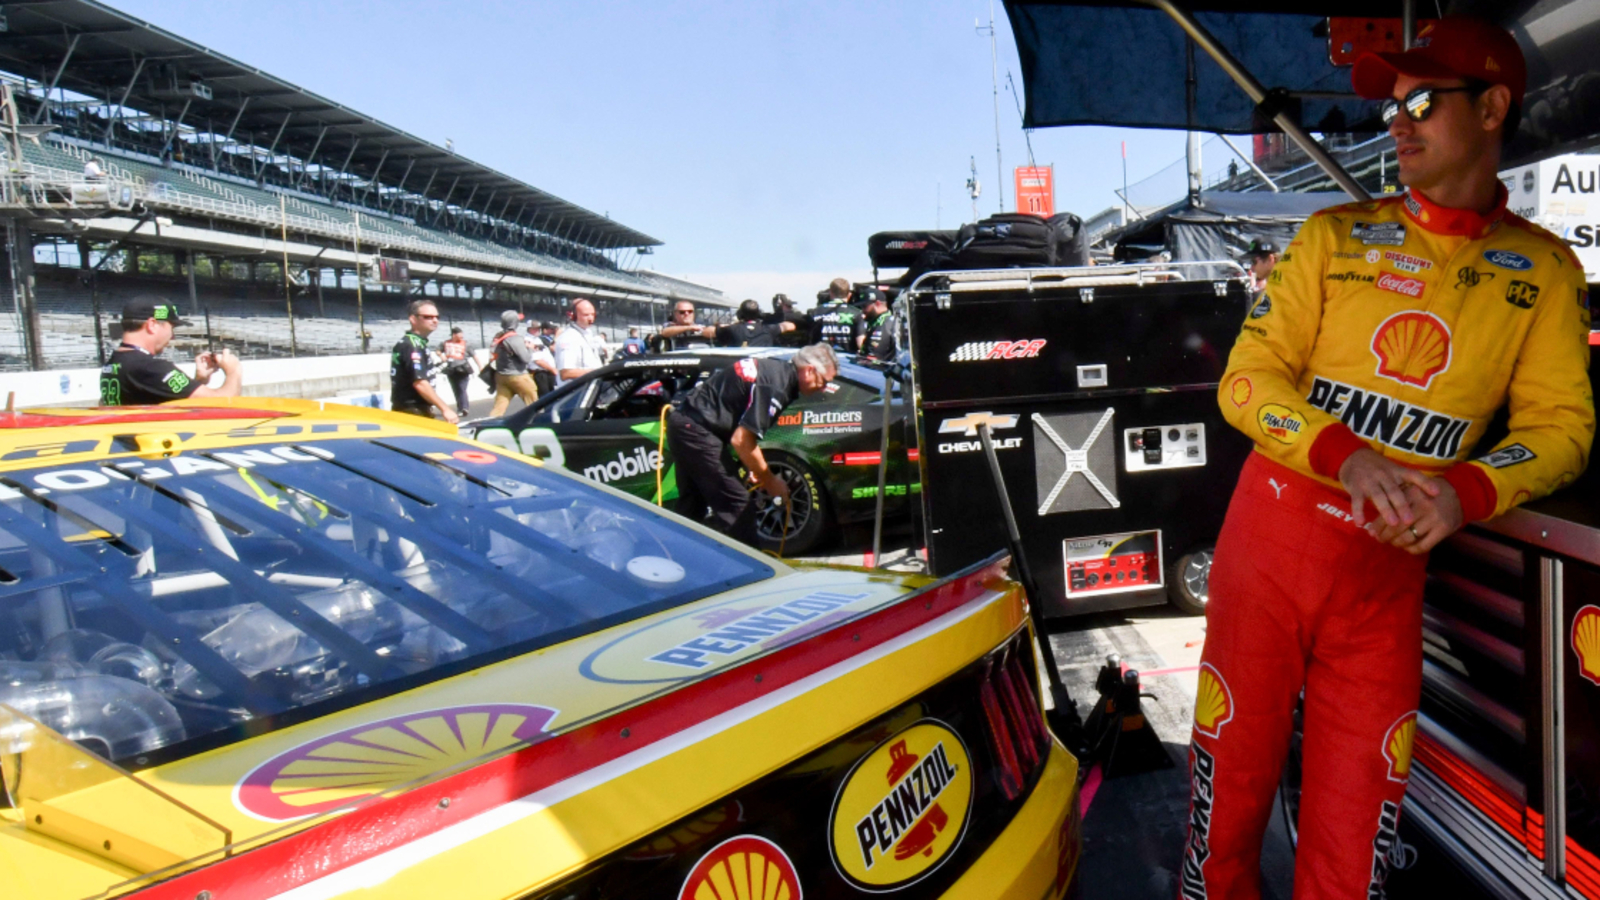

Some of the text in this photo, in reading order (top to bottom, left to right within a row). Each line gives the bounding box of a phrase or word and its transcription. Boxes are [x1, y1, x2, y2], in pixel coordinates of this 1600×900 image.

[1384, 185, 1397, 193] 29
[1551, 163, 1600, 194] Au
[1029, 197, 1041, 213] 11
[1384, 251, 1432, 270] DISCOUNT
[1395, 261, 1416, 273] TIRE
[1491, 251, 1524, 268] Ford
[1377, 273, 1424, 297] Coca-Cola
[1507, 283, 1538, 305] PPG
[985, 338, 1047, 360] RCR
[803, 410, 863, 425] Partners
[1262, 412, 1302, 433] PENNZOIL
[1307, 375, 1472, 460] PENNZOIL
[802, 425, 862, 435] Financial Services
[584, 446, 665, 483] mobile
[804, 473, 820, 510] EAGLE
[1317, 503, 1353, 522] JOEY
[644, 591, 870, 668] PENNZOIL
[854, 740, 957, 871] PENNZOIL
